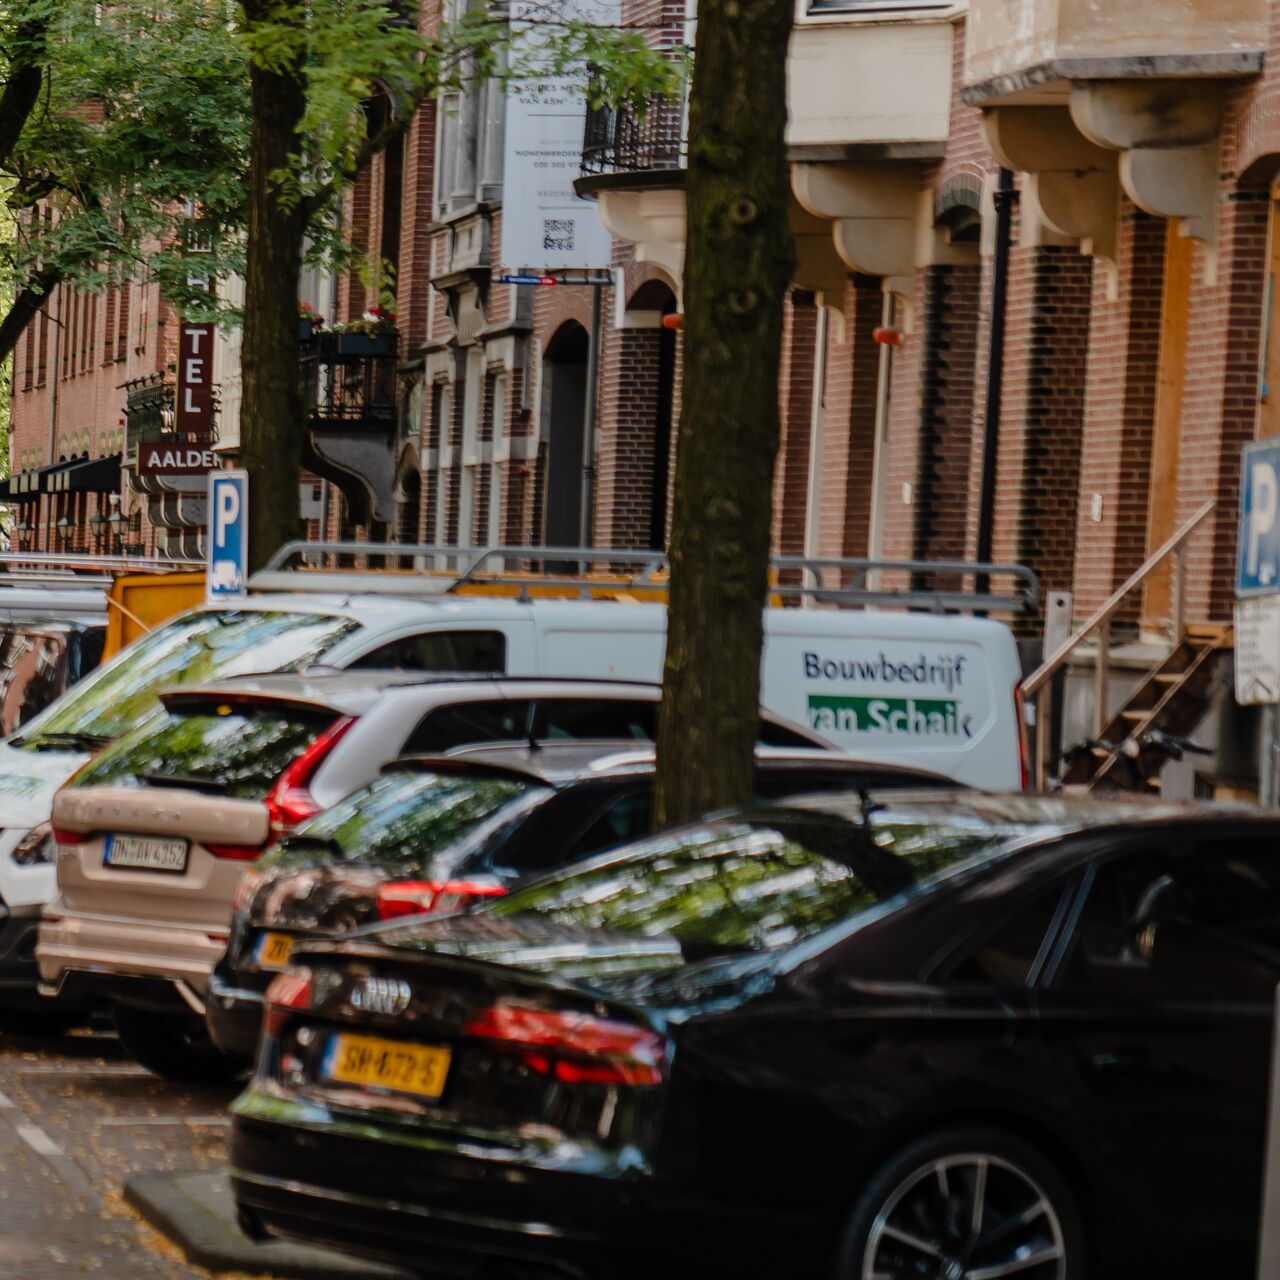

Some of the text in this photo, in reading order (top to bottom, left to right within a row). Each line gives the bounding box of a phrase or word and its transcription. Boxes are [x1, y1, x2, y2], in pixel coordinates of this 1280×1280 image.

[216, 483, 240, 548] P
[803, 652, 968, 693] Bouwbedrijf
[866, 698, 973, 739] Schaik
